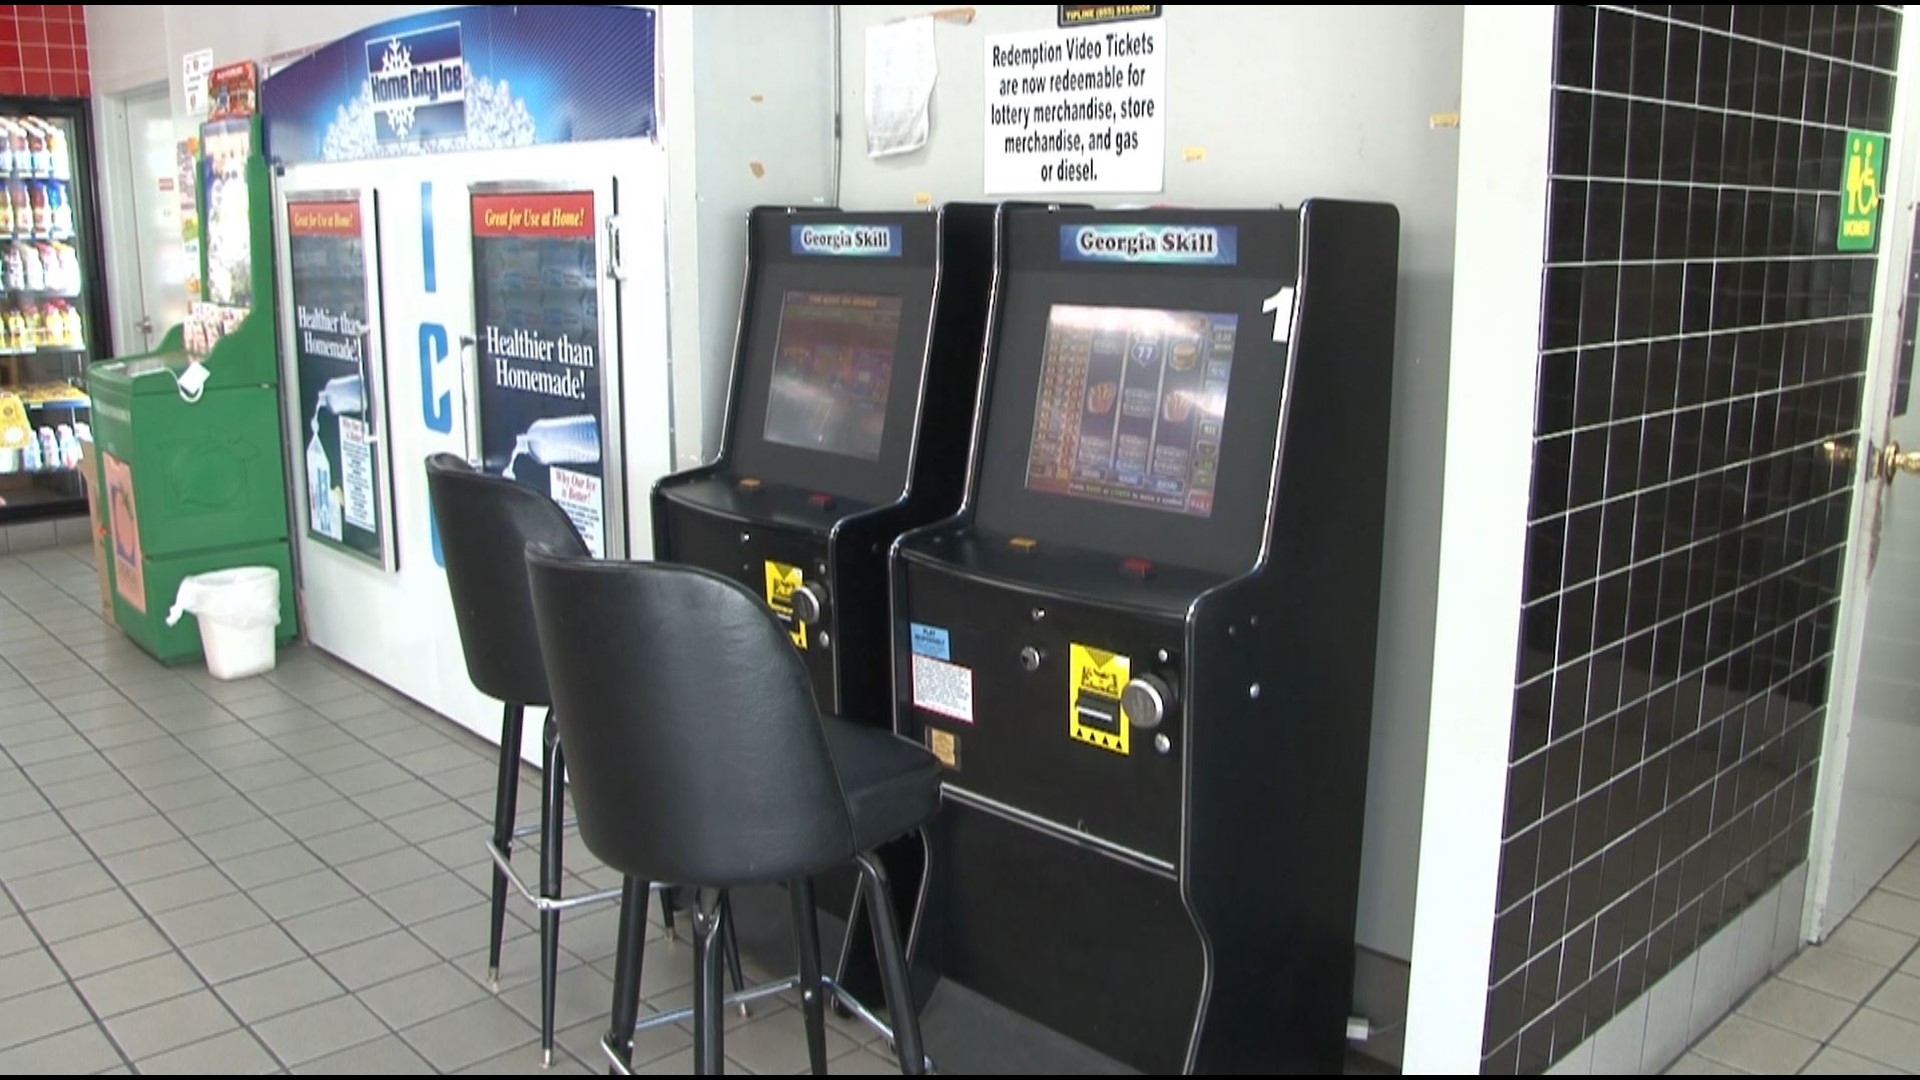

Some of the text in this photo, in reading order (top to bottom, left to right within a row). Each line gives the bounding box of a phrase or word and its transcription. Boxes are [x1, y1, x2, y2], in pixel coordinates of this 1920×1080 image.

[1066, 8, 1095, 21] TIPLINE
[993, 32, 1154, 70] Redemption Video Tickets
[371, 63, 462, 103] Home City Ice
[1000, 62, 1145, 96] are now redeemable for
[991, 95, 1155, 130] lottery merchandise, store
[1005, 126, 1138, 157] merchandise, and gas
[1041, 156, 1098, 182] or diesel.
[485, 207, 585, 231] Great for Use at Home!
[803, 228, 888, 250] Georgia Skill
[1080, 230, 1214, 255] Georgia Skill
[298, 305, 339, 333] Healthier
[1262, 286, 1296, 343] 1
[304, 331, 358, 362] Homemade!
[487, 325, 594, 368] Healthier than
[495, 357, 586, 400] Homemade!
[556, 470, 570, 487] Why
